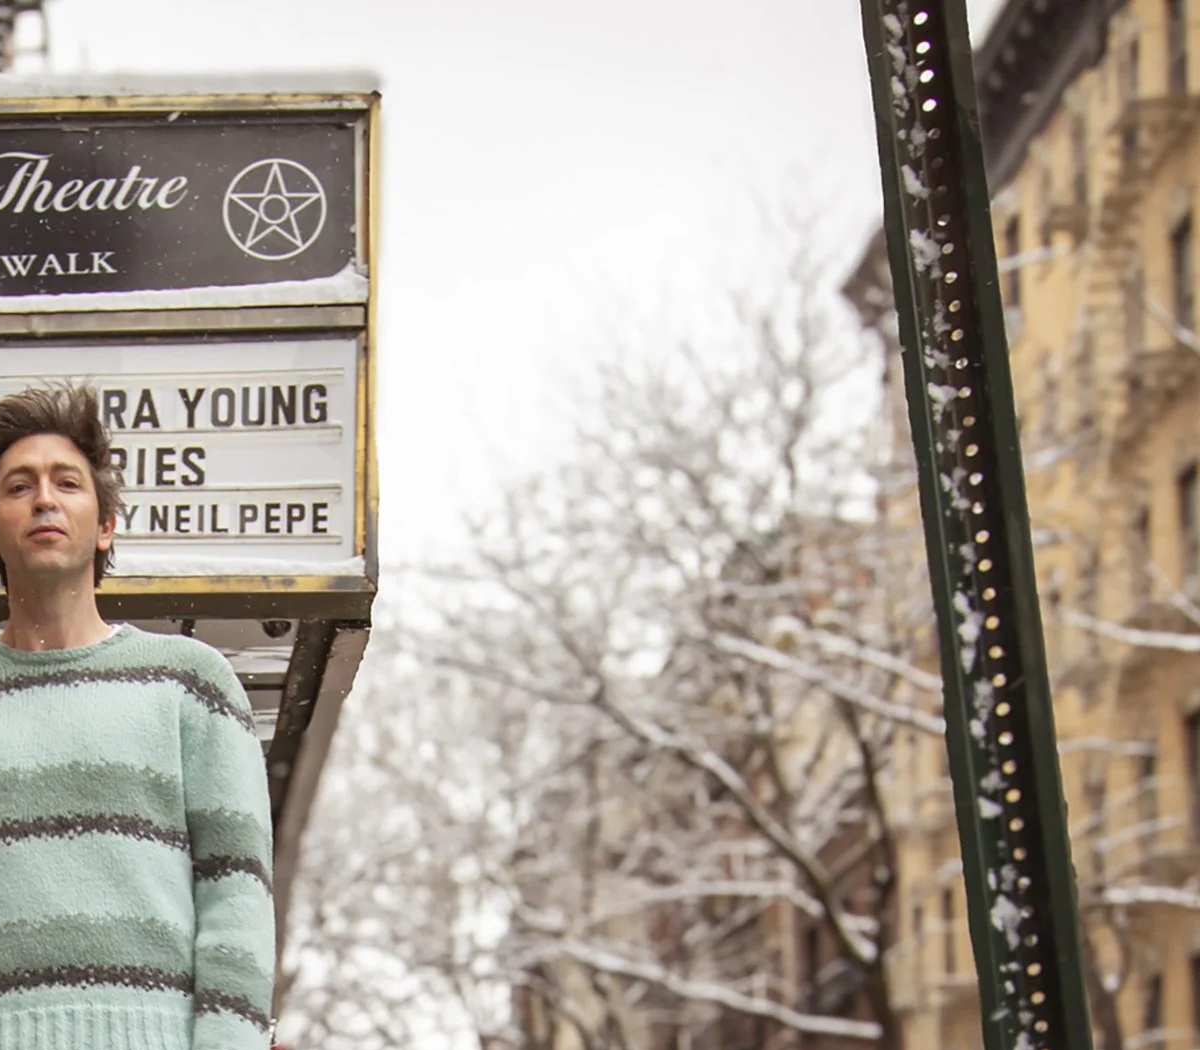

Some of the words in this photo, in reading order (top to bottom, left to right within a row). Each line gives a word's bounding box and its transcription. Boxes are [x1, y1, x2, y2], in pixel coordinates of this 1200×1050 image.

[102, 388, 160, 429] RA
[177, 383, 328, 429] YOUNG
[109, 446, 206, 487] RIES
[150, 503, 229, 534] NEIL
[239, 502, 329, 534] PEPE
